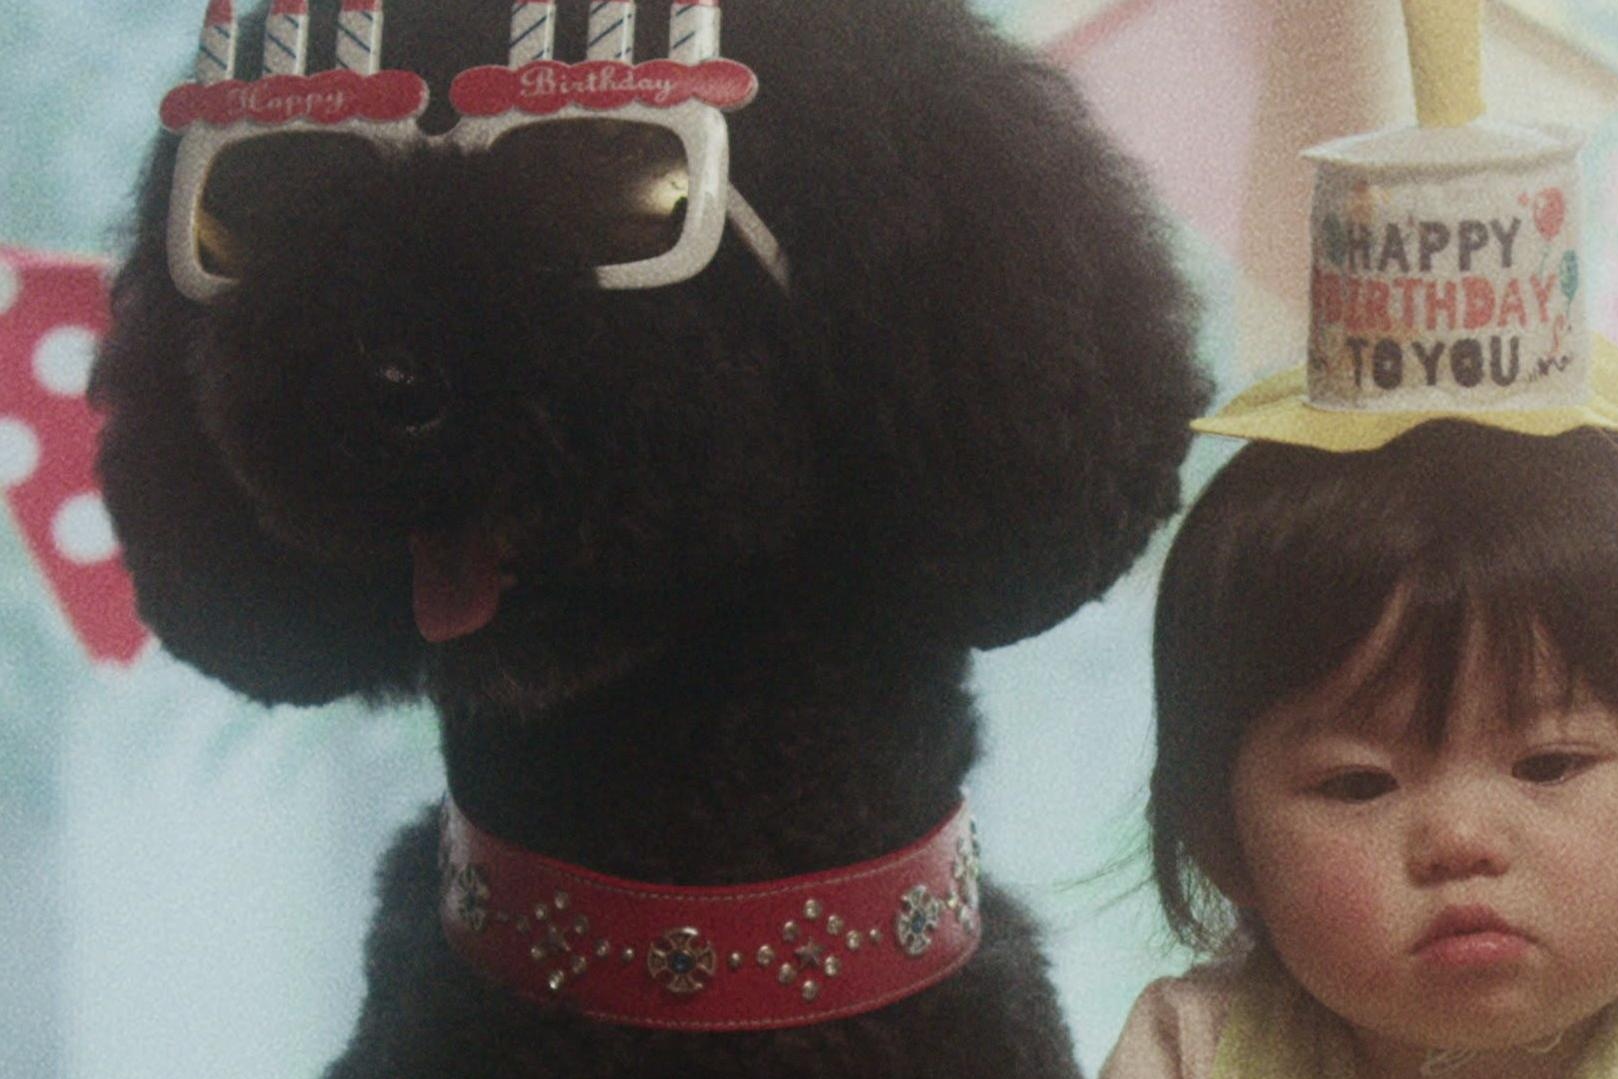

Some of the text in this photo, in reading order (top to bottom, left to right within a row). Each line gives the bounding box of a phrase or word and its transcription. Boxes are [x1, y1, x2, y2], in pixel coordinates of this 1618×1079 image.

[226, 65, 675, 116] Happy Birthday
[1347, 216, 1522, 273] HAPPY
[1312, 271, 1557, 332] BIRTHDAY
[1345, 335, 1520, 391] TO YOU
